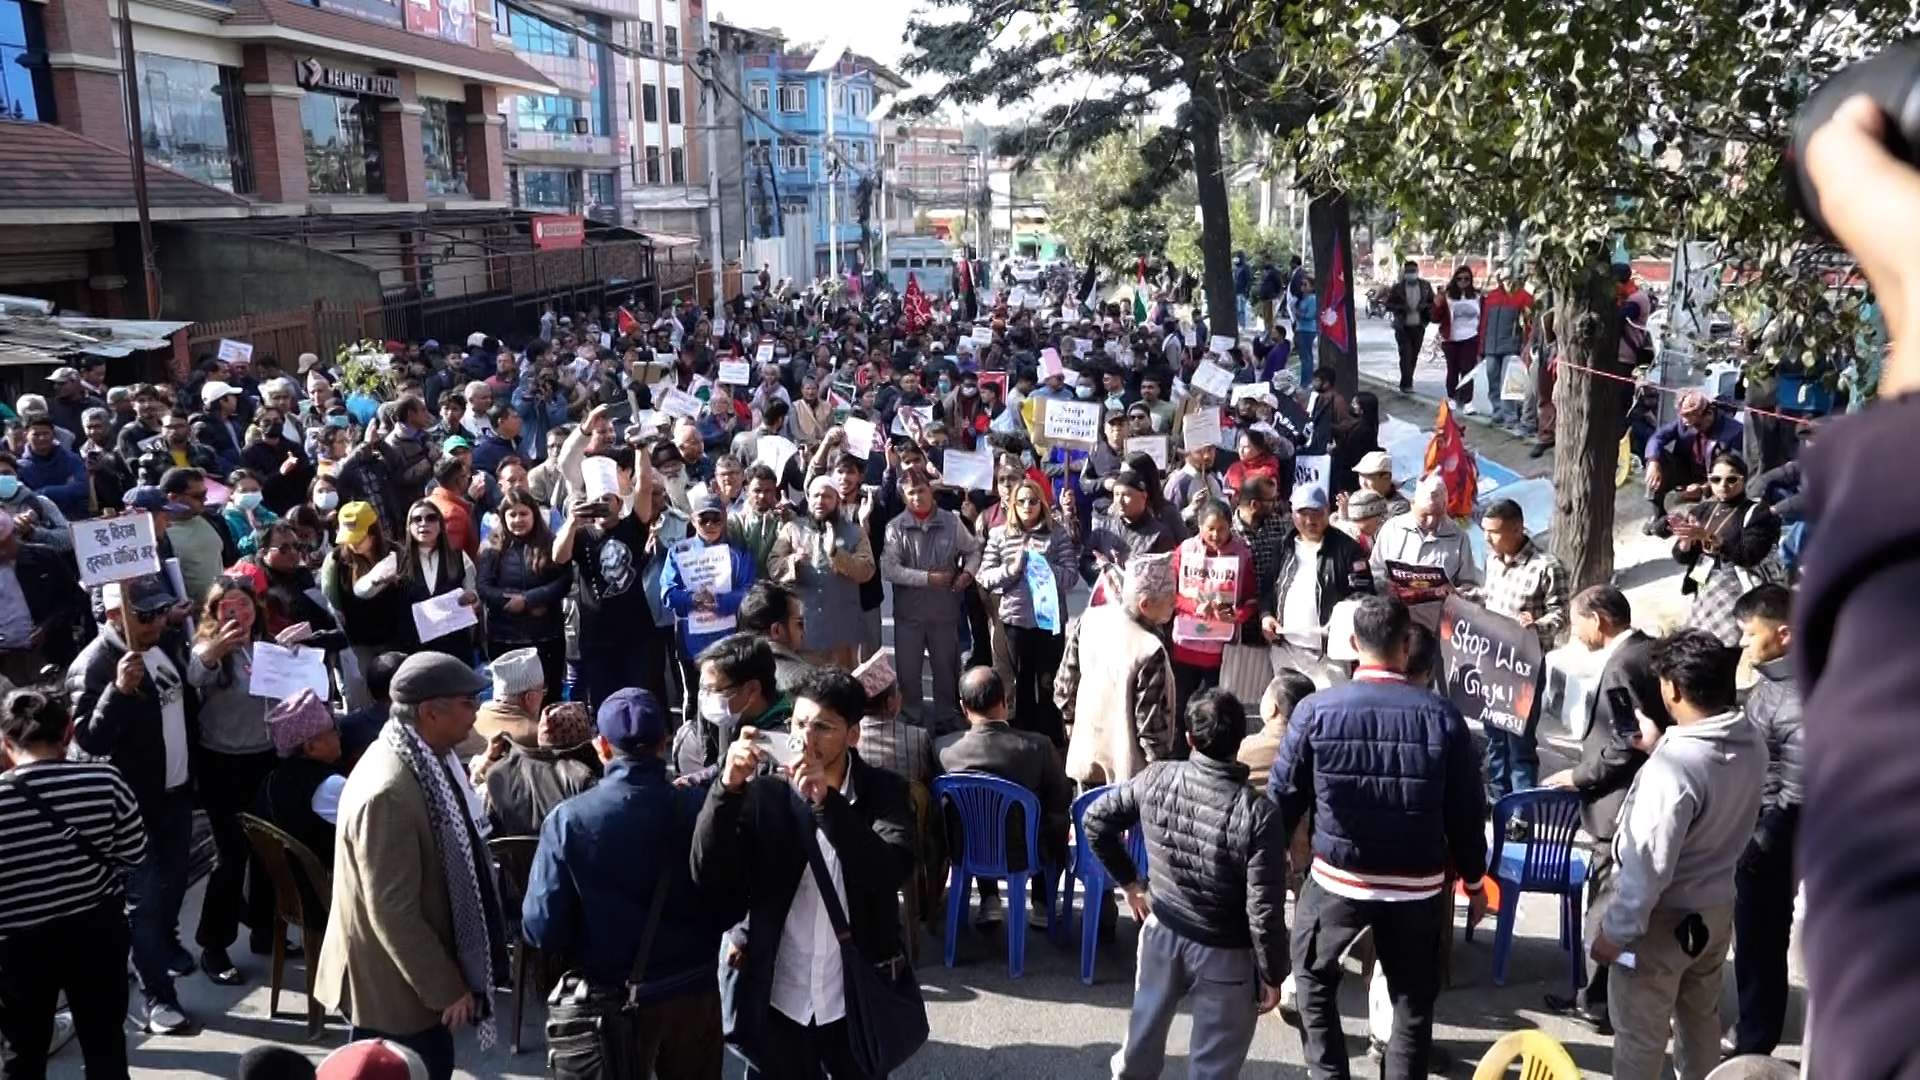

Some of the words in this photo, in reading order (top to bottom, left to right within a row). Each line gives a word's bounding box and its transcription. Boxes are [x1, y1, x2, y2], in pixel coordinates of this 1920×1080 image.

[1451, 619, 1490, 669] Stop
[1495, 641, 1533, 677] War
[1448, 655, 1460, 683] in
[1464, 668, 1513, 707] Gaza!
